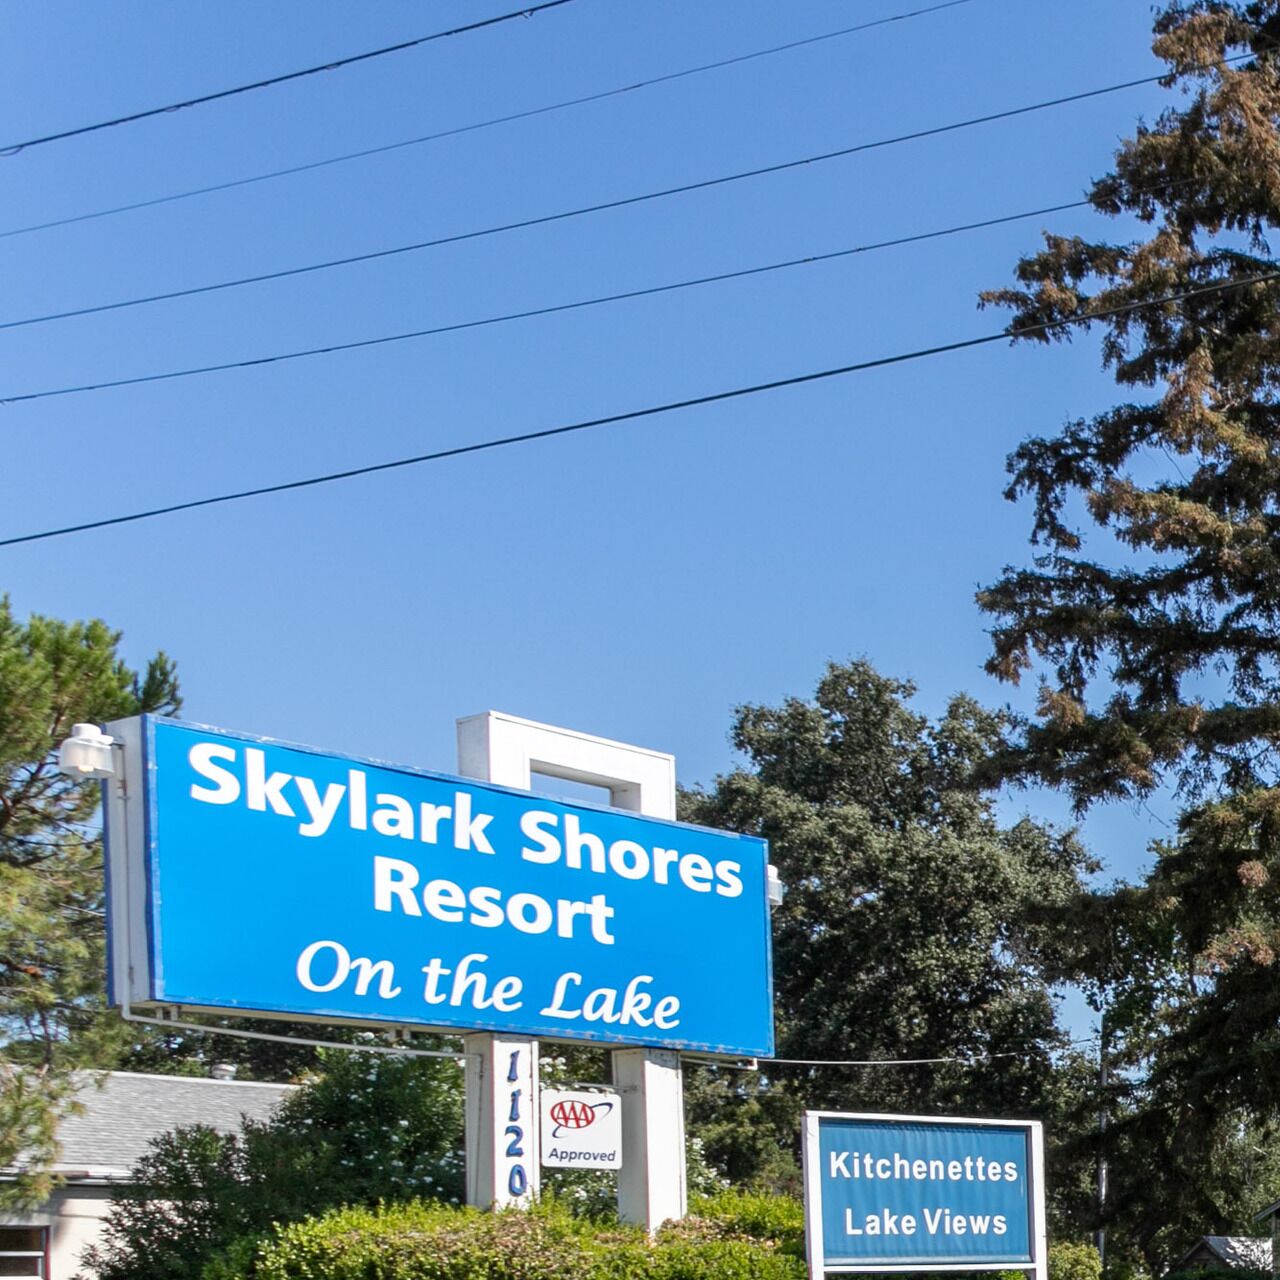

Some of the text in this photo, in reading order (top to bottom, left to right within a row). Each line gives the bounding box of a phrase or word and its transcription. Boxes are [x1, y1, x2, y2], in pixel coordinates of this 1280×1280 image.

[189, 743, 744, 898] Skylark Shores
[374, 856, 616, 945] Resort
[296, 940, 681, 1029] On the Lake
[504, 1050, 528, 1197] 1120
[552, 1100, 594, 1129] AAA
[548, 1147, 617, 1163] Approved
[830, 1151, 1019, 1182] Kitchenettes
[845, 1207, 1008, 1236] Lake Views
